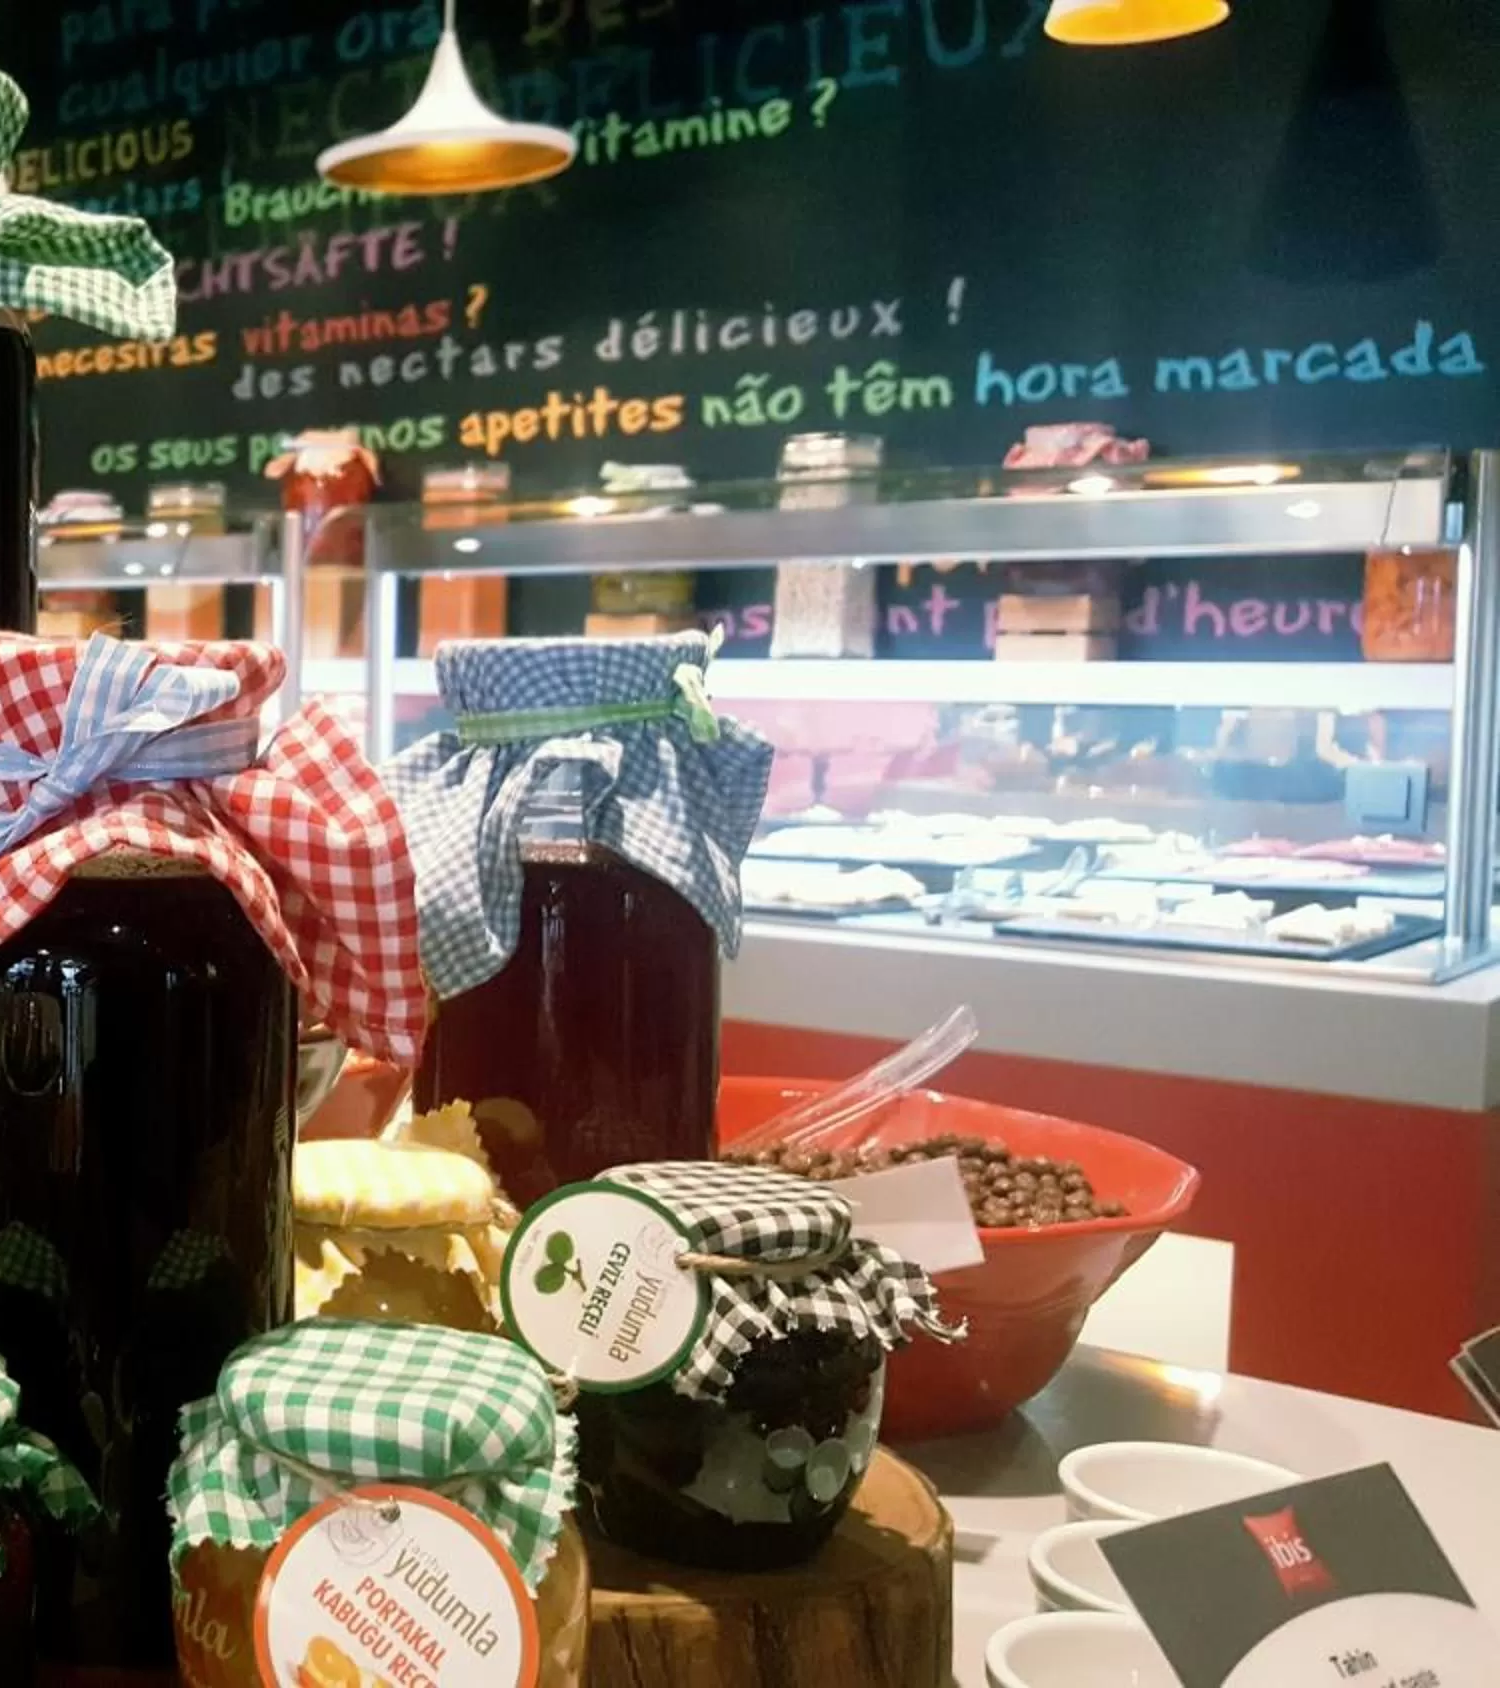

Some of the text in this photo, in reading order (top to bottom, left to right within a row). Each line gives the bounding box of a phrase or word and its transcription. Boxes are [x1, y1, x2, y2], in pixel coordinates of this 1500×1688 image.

[574, 96, 792, 166] itamine
[810, 77, 839, 127] ?
[176, 222, 425, 301] CHTSÄFTE
[35, 284, 489, 380] necesitas vitaminas ?
[232, 277, 966, 401] des nectars délicieux !
[91, 442, 138, 474] os
[149, 436, 237, 471] seus
[460, 388, 683, 456] apetites
[702, 374, 802, 428] não
[825, 361, 951, 417] têm
[977, 352, 1129, 404] hora
[1155, 320, 1484, 391] marcada
[1263, 1531, 1313, 1570] ibis
[312, 1578, 394, 1661] KABUĞU
[356, 1575, 449, 1671] PORTAKAL
